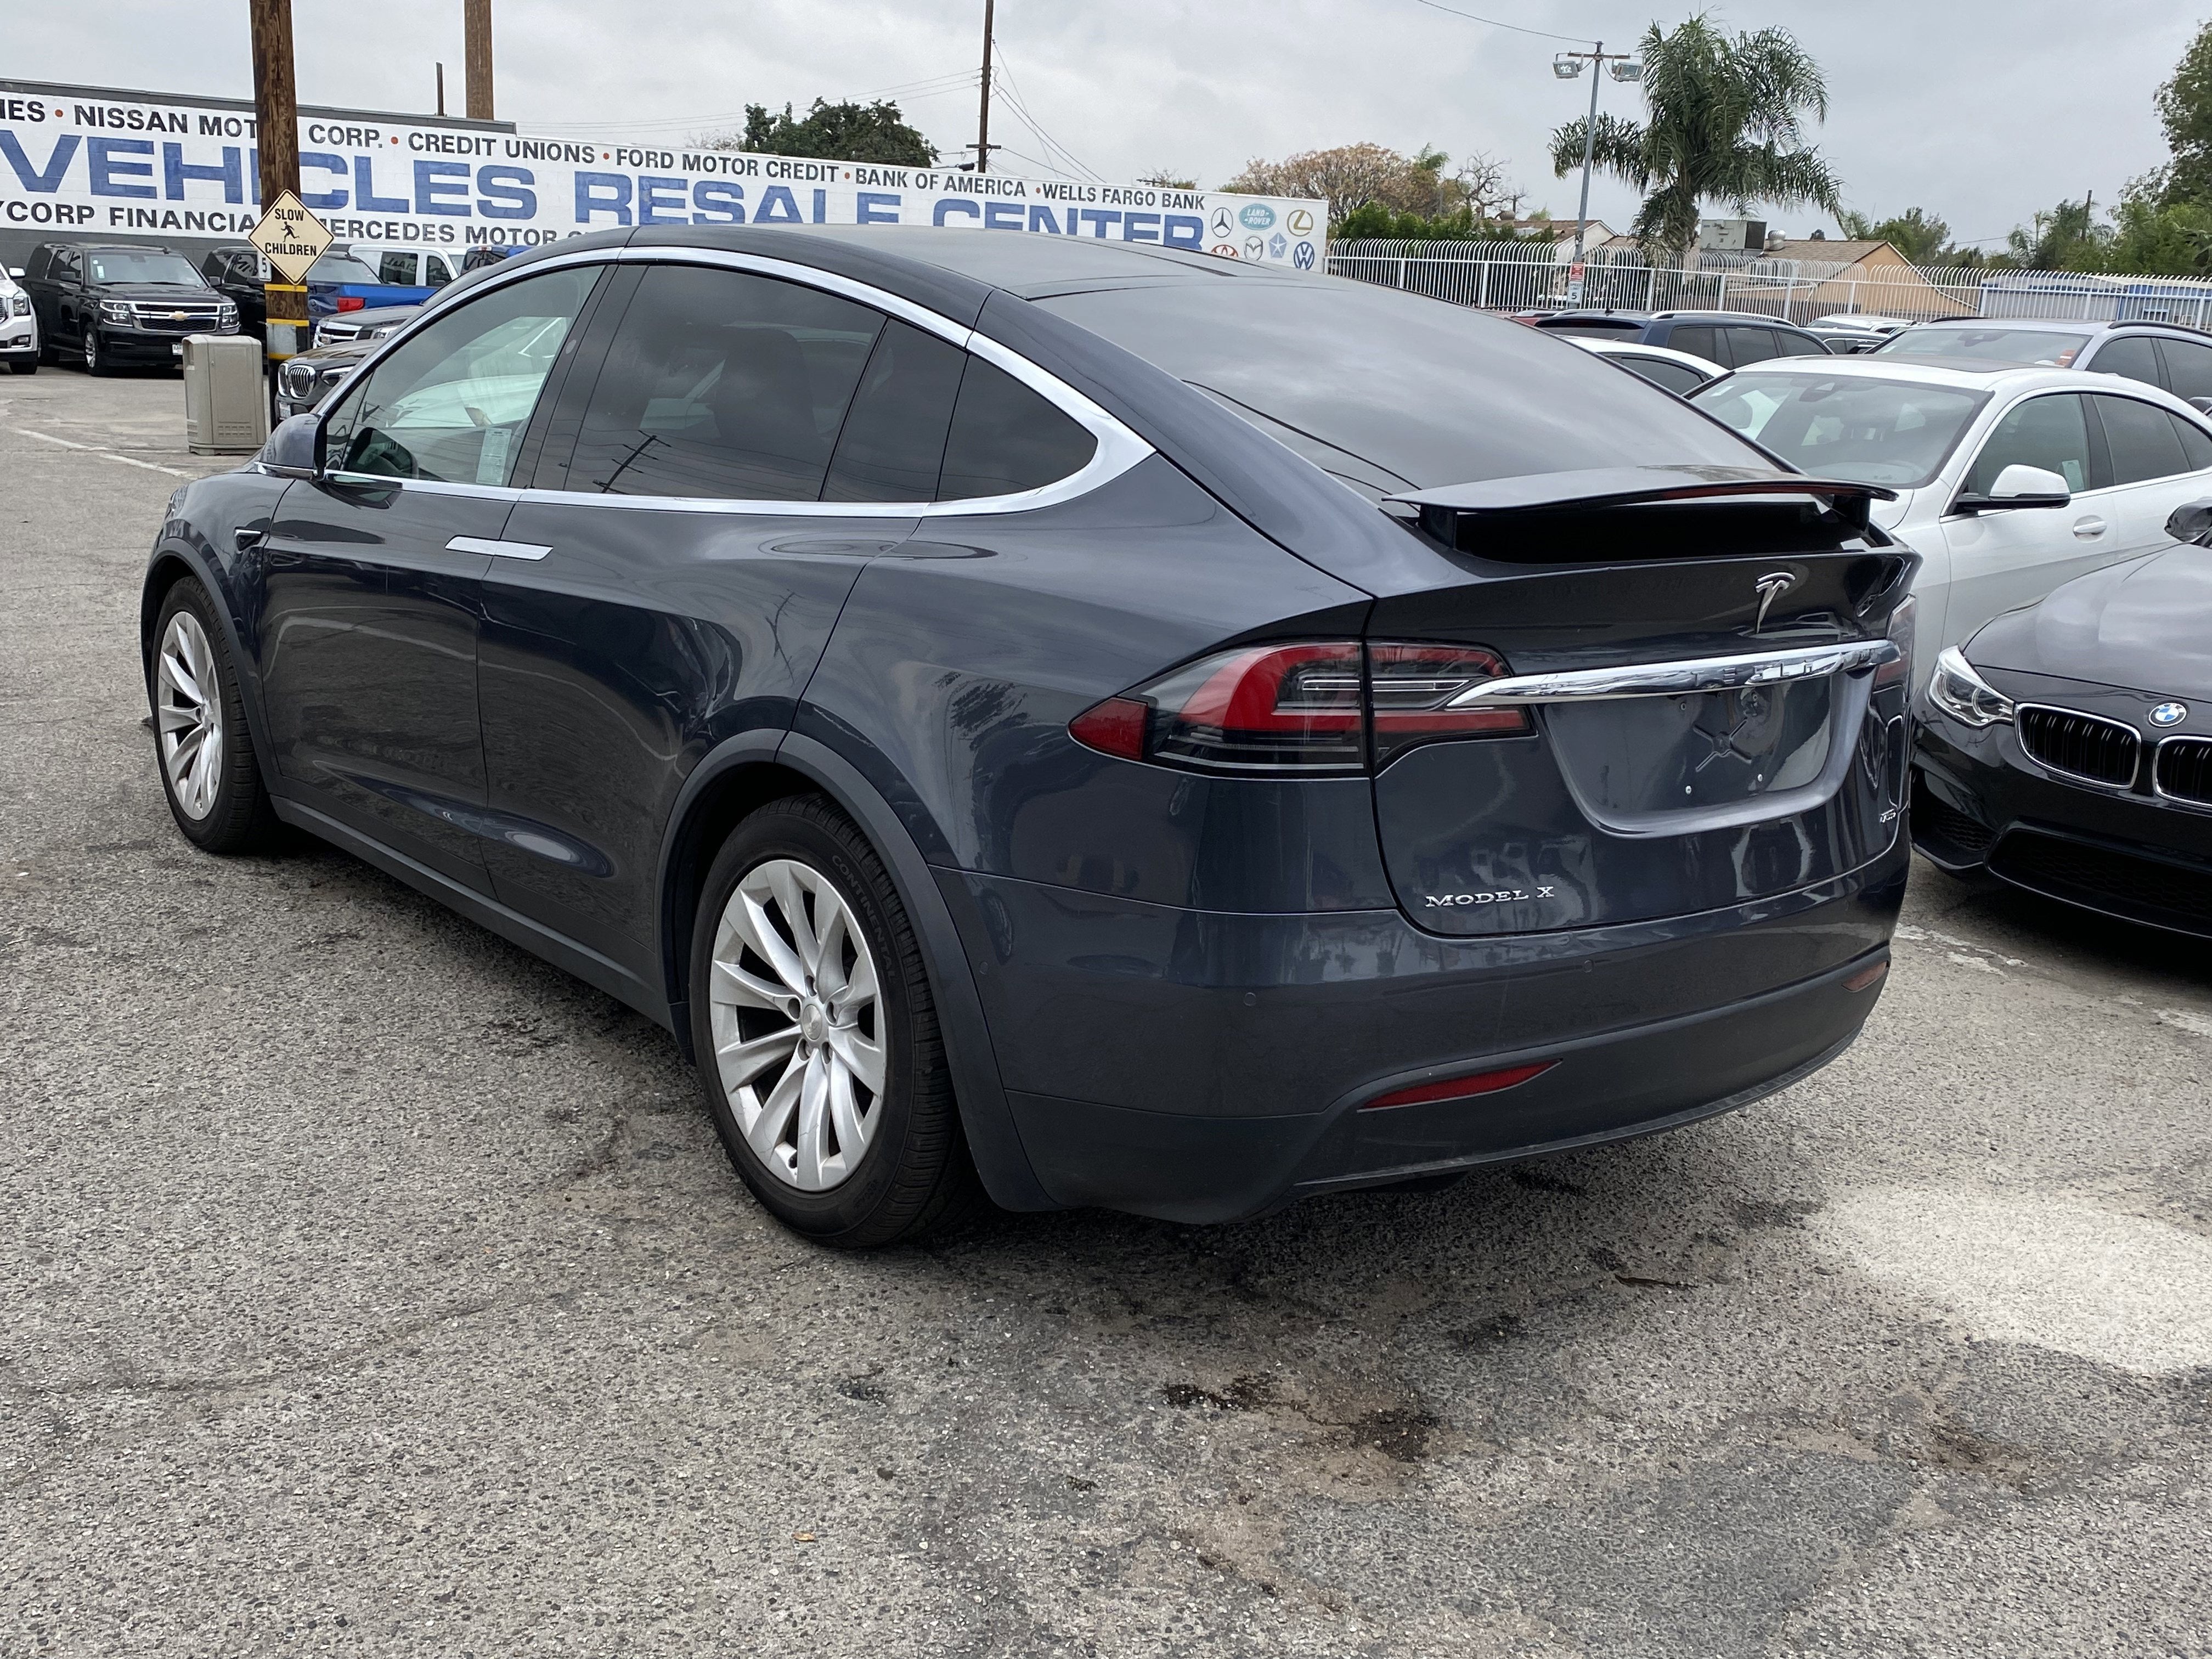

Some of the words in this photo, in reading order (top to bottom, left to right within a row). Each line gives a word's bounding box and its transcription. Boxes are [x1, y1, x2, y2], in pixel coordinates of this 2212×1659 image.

[75, 105, 188, 133] NISSAN
[199, 115, 257, 139] MOT
[308, 124, 382, 148] CORP.
[408, 132, 496, 156] CREDIT
[505, 139, 595, 163] UNIONS
[616, 148, 674, 169] FORD
[682, 154, 758, 176] MOTOR
[766, 161, 839, 182] CREDIT
[856, 167, 908, 188] BANK
[915, 172, 938, 190] OF
[944, 176, 1026, 197] AMERICA
[1043, 183, 1096, 202] WELLS
[1102, 188, 1155, 206] FARGO
[1162, 193, 1205, 210] BANK
[0, 201, 95, 224] CORP
[110, 207, 256, 232] FINANCIA
[275, 208, 304, 221] SLOW
[466, 225, 557, 246] MOTOR
[265, 242, 317, 256] CHILDREN
[262, 258, 267, 273] 5
[1425, 890, 1529, 907] MODEL
[1537, 886, 1555, 899] X
[832, 855, 895, 984] CONTINENTAL
